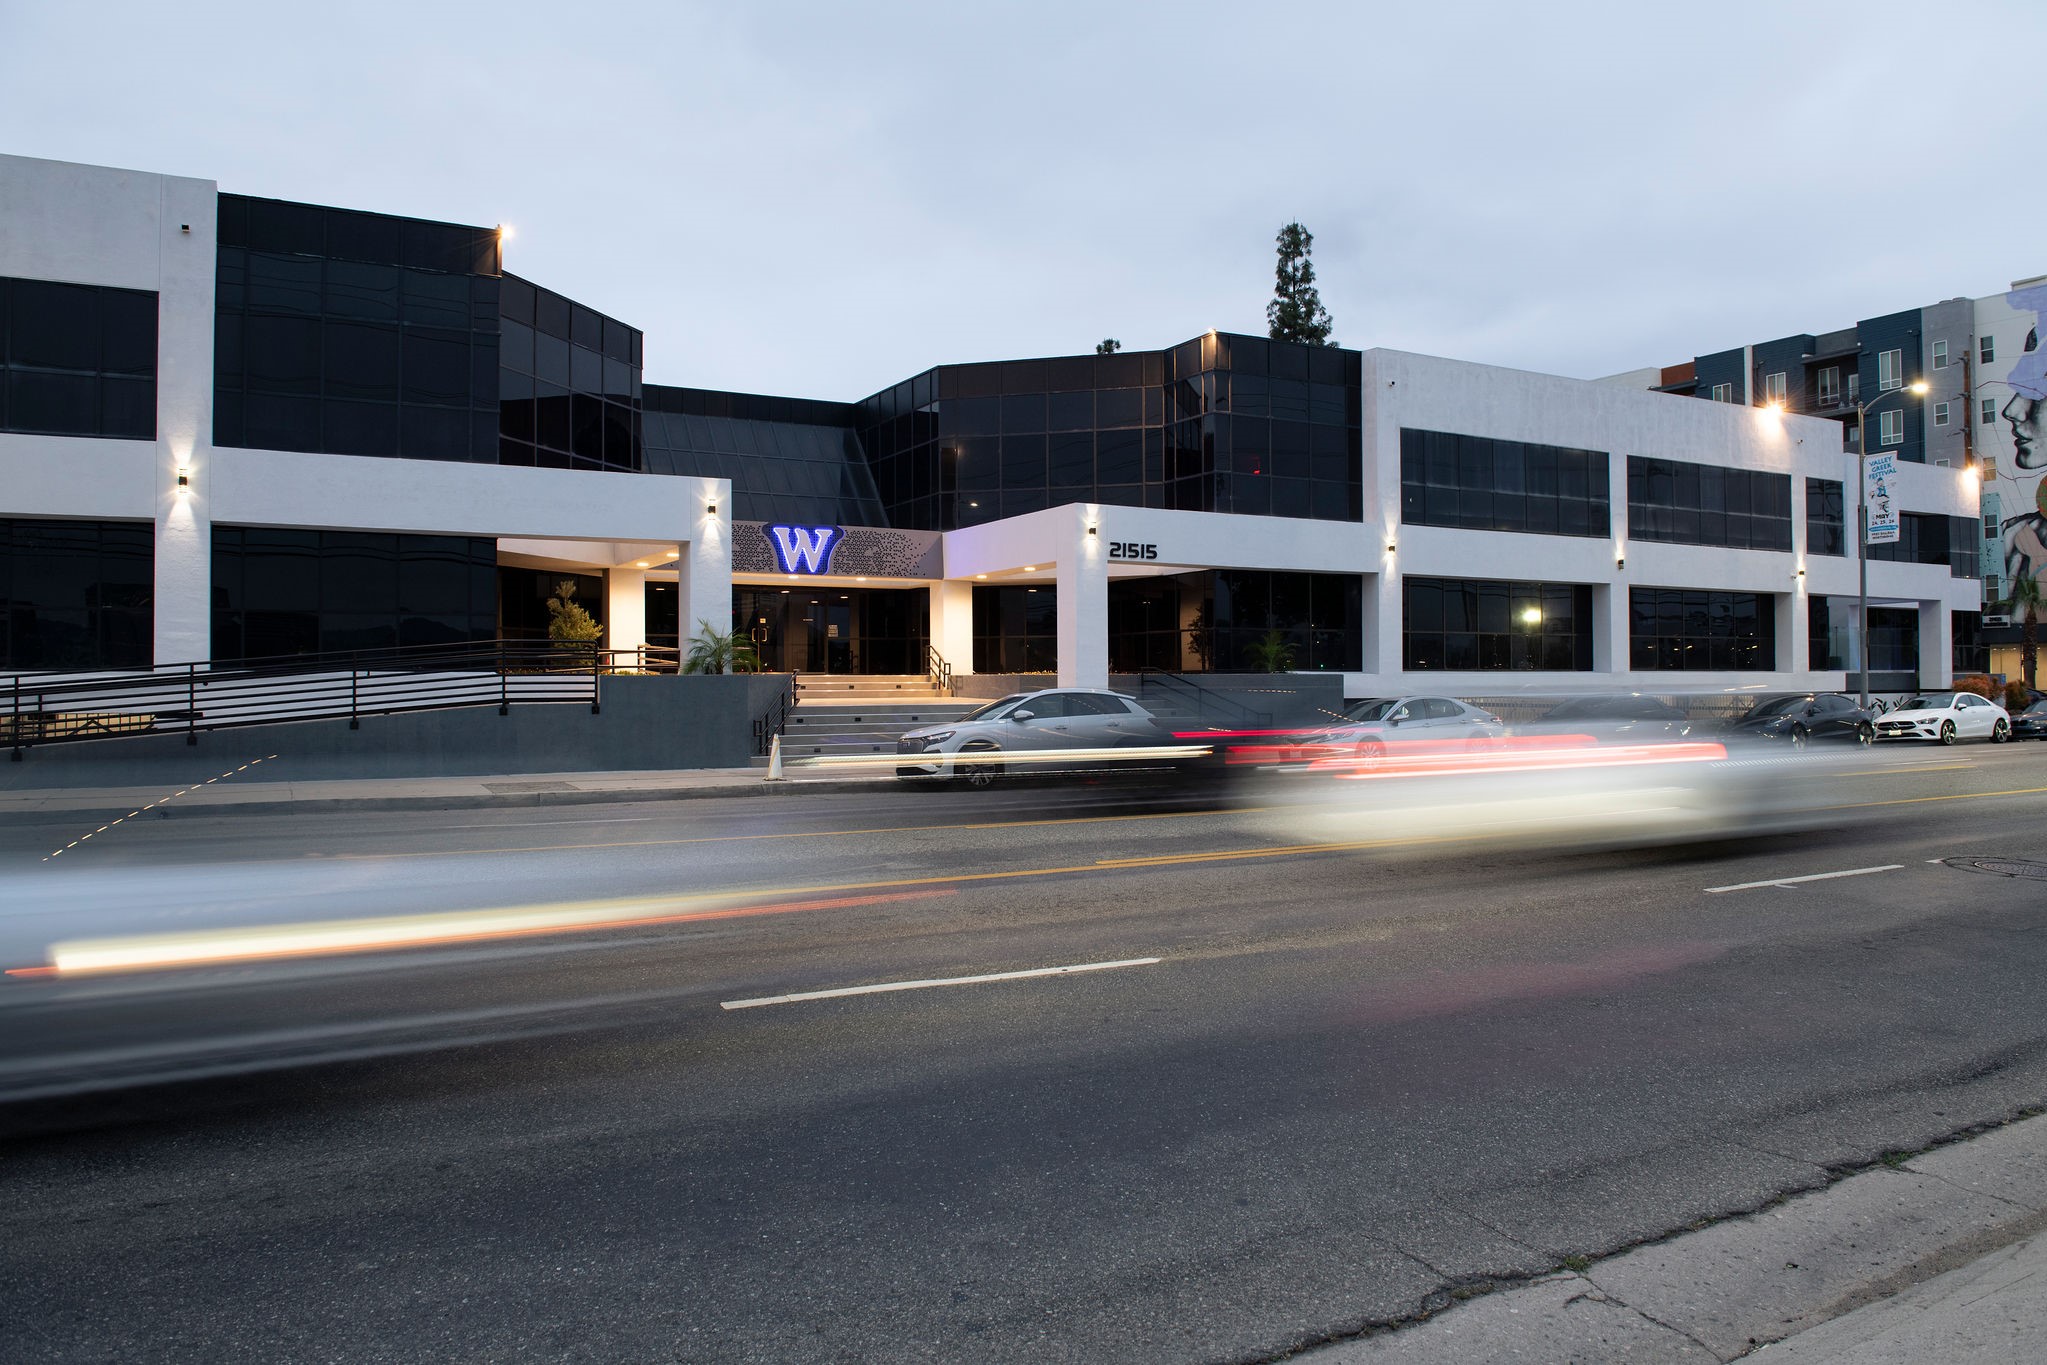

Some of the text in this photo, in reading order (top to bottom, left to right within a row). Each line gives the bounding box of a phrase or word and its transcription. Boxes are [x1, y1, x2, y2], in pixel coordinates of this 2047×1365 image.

[1869, 456, 1892, 466] VALLEY
[1871, 463, 1892, 472] GREEK
[1869, 467, 1897, 480] FESTIVAL
[773, 527, 834, 573] W
[1109, 542, 1158, 559] 21515
